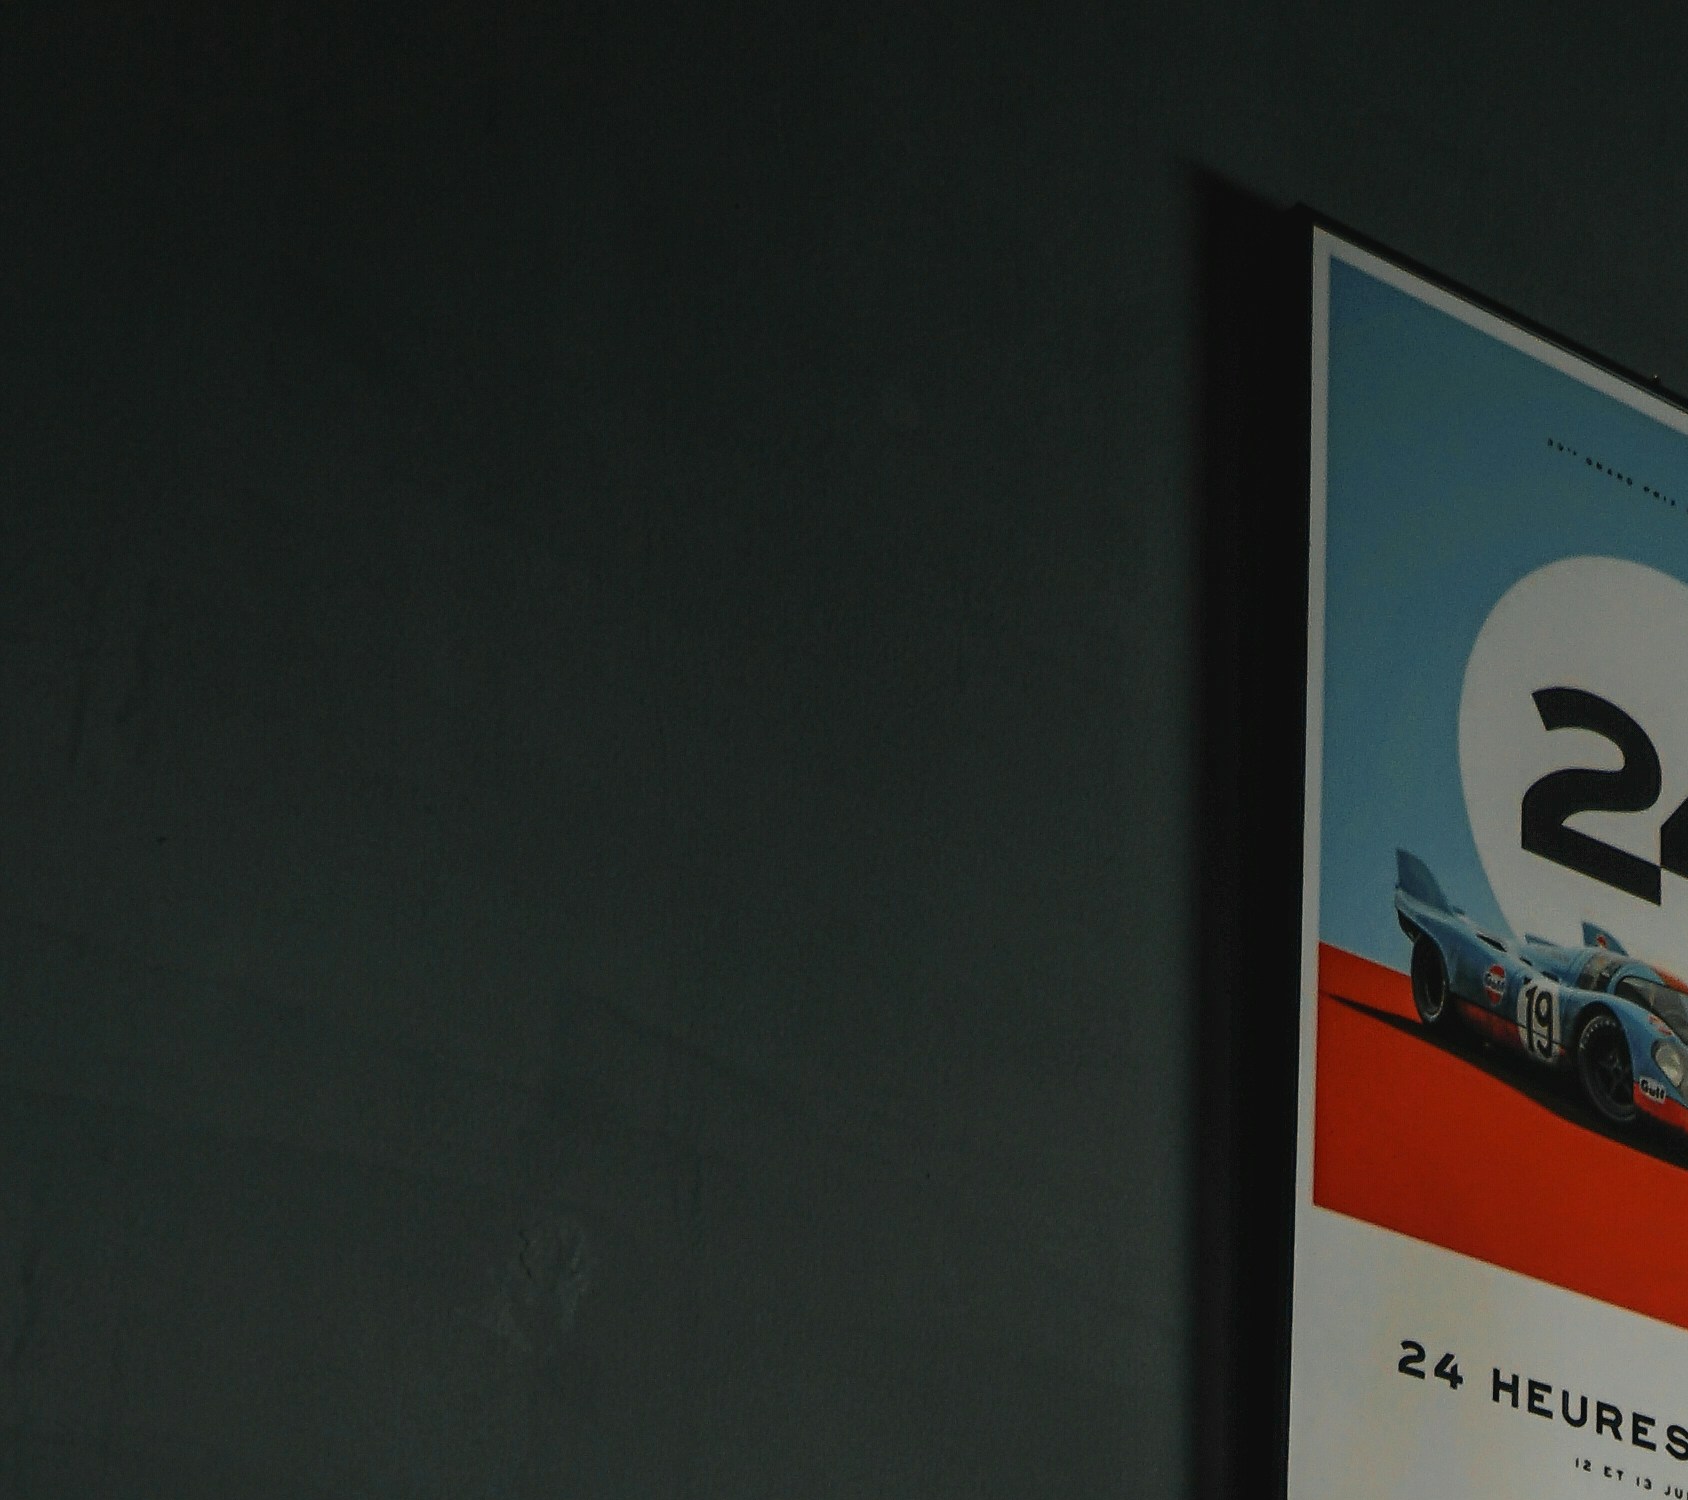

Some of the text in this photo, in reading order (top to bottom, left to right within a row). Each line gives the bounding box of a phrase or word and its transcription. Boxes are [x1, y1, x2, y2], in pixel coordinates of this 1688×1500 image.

[1523, 980, 1555, 1051] 19
[1397, 1339, 1463, 1392] 24
[1575, 1457, 1593, 1473] 12
[1603, 1466, 1624, 1482] ET
[1635, 1476, 1652, 1490] 13
